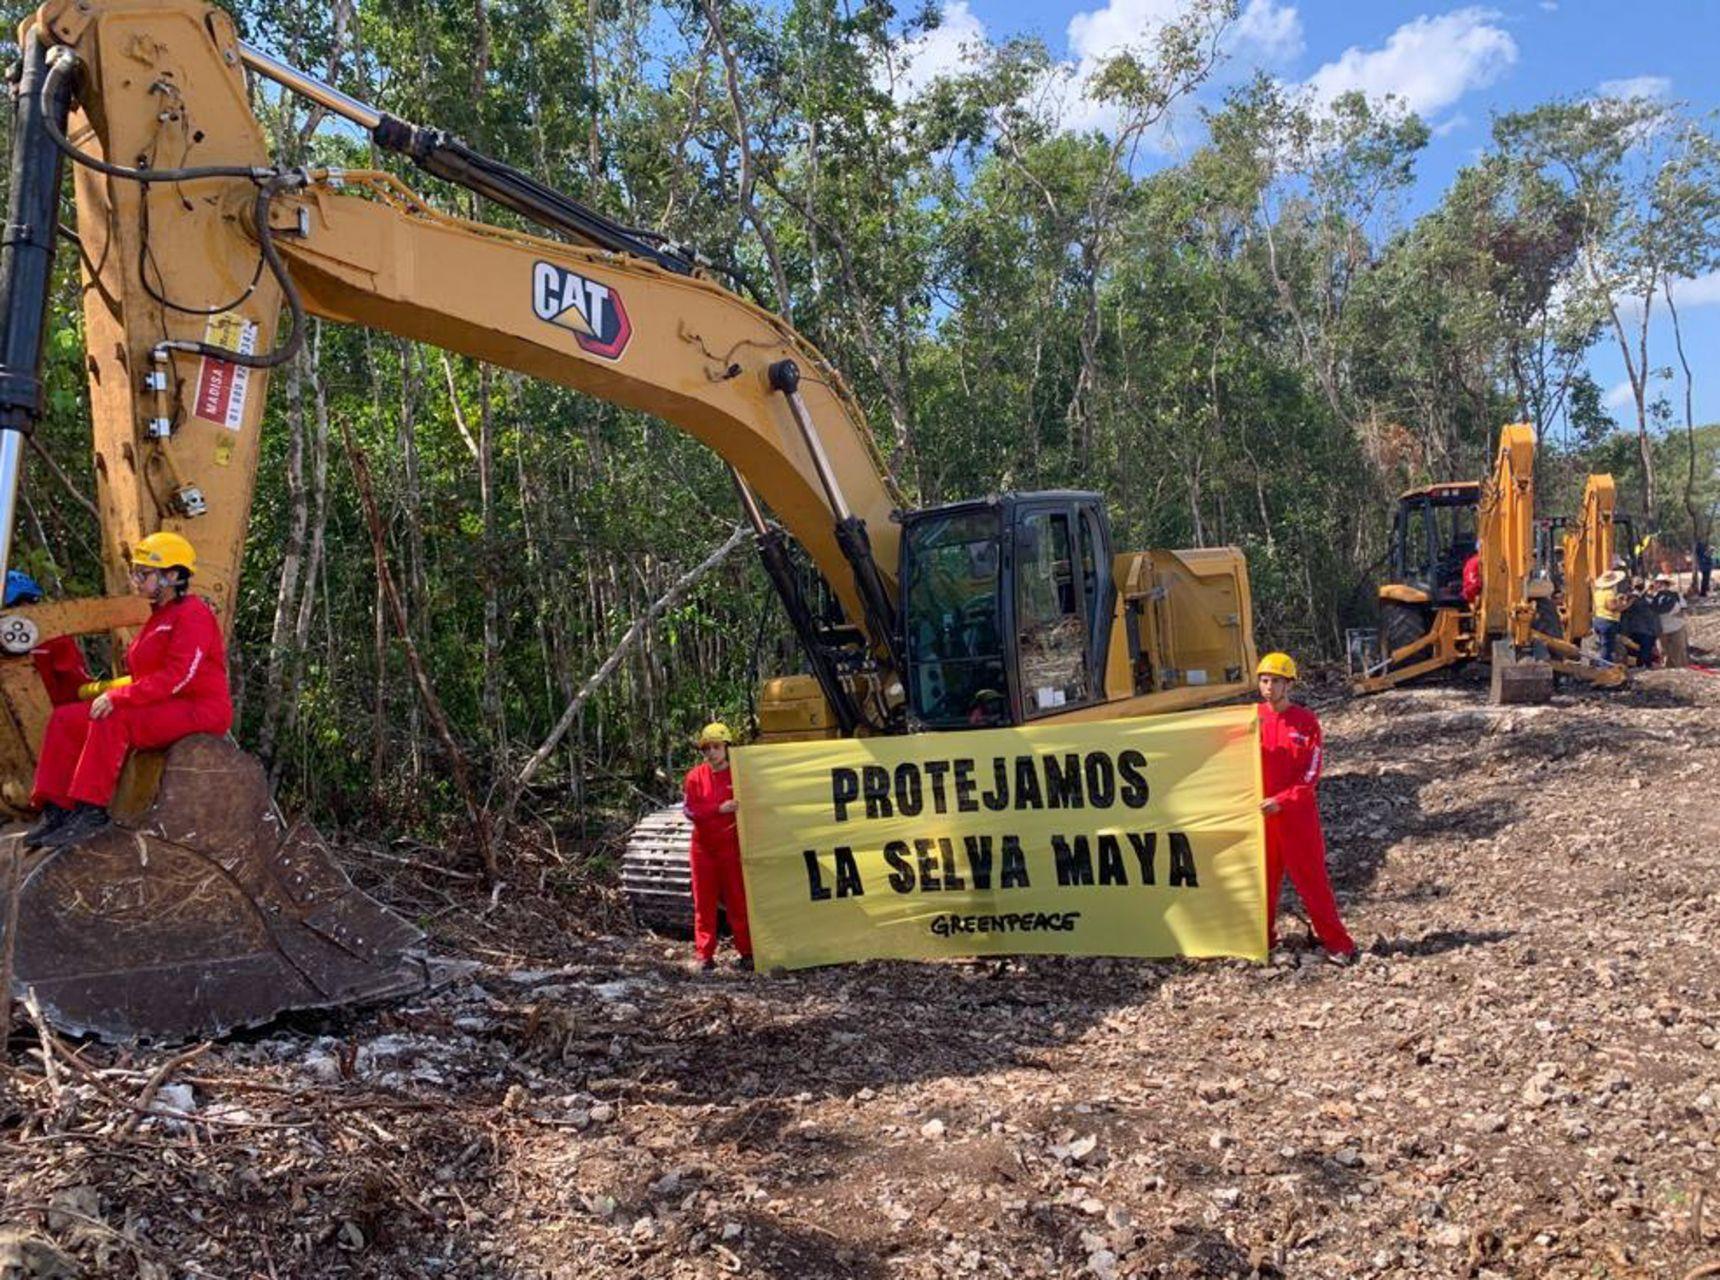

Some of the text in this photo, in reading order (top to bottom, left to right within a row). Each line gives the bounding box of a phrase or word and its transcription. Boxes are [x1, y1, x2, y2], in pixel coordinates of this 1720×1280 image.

[534, 262, 608, 338] CAT
[205, 369, 223, 415] MADISA
[831, 750, 1150, 822] PROTEJAMOS
[803, 832, 1200, 901] LA SELVA MAYA
[930, 912, 1080, 937] GREENPEACE
